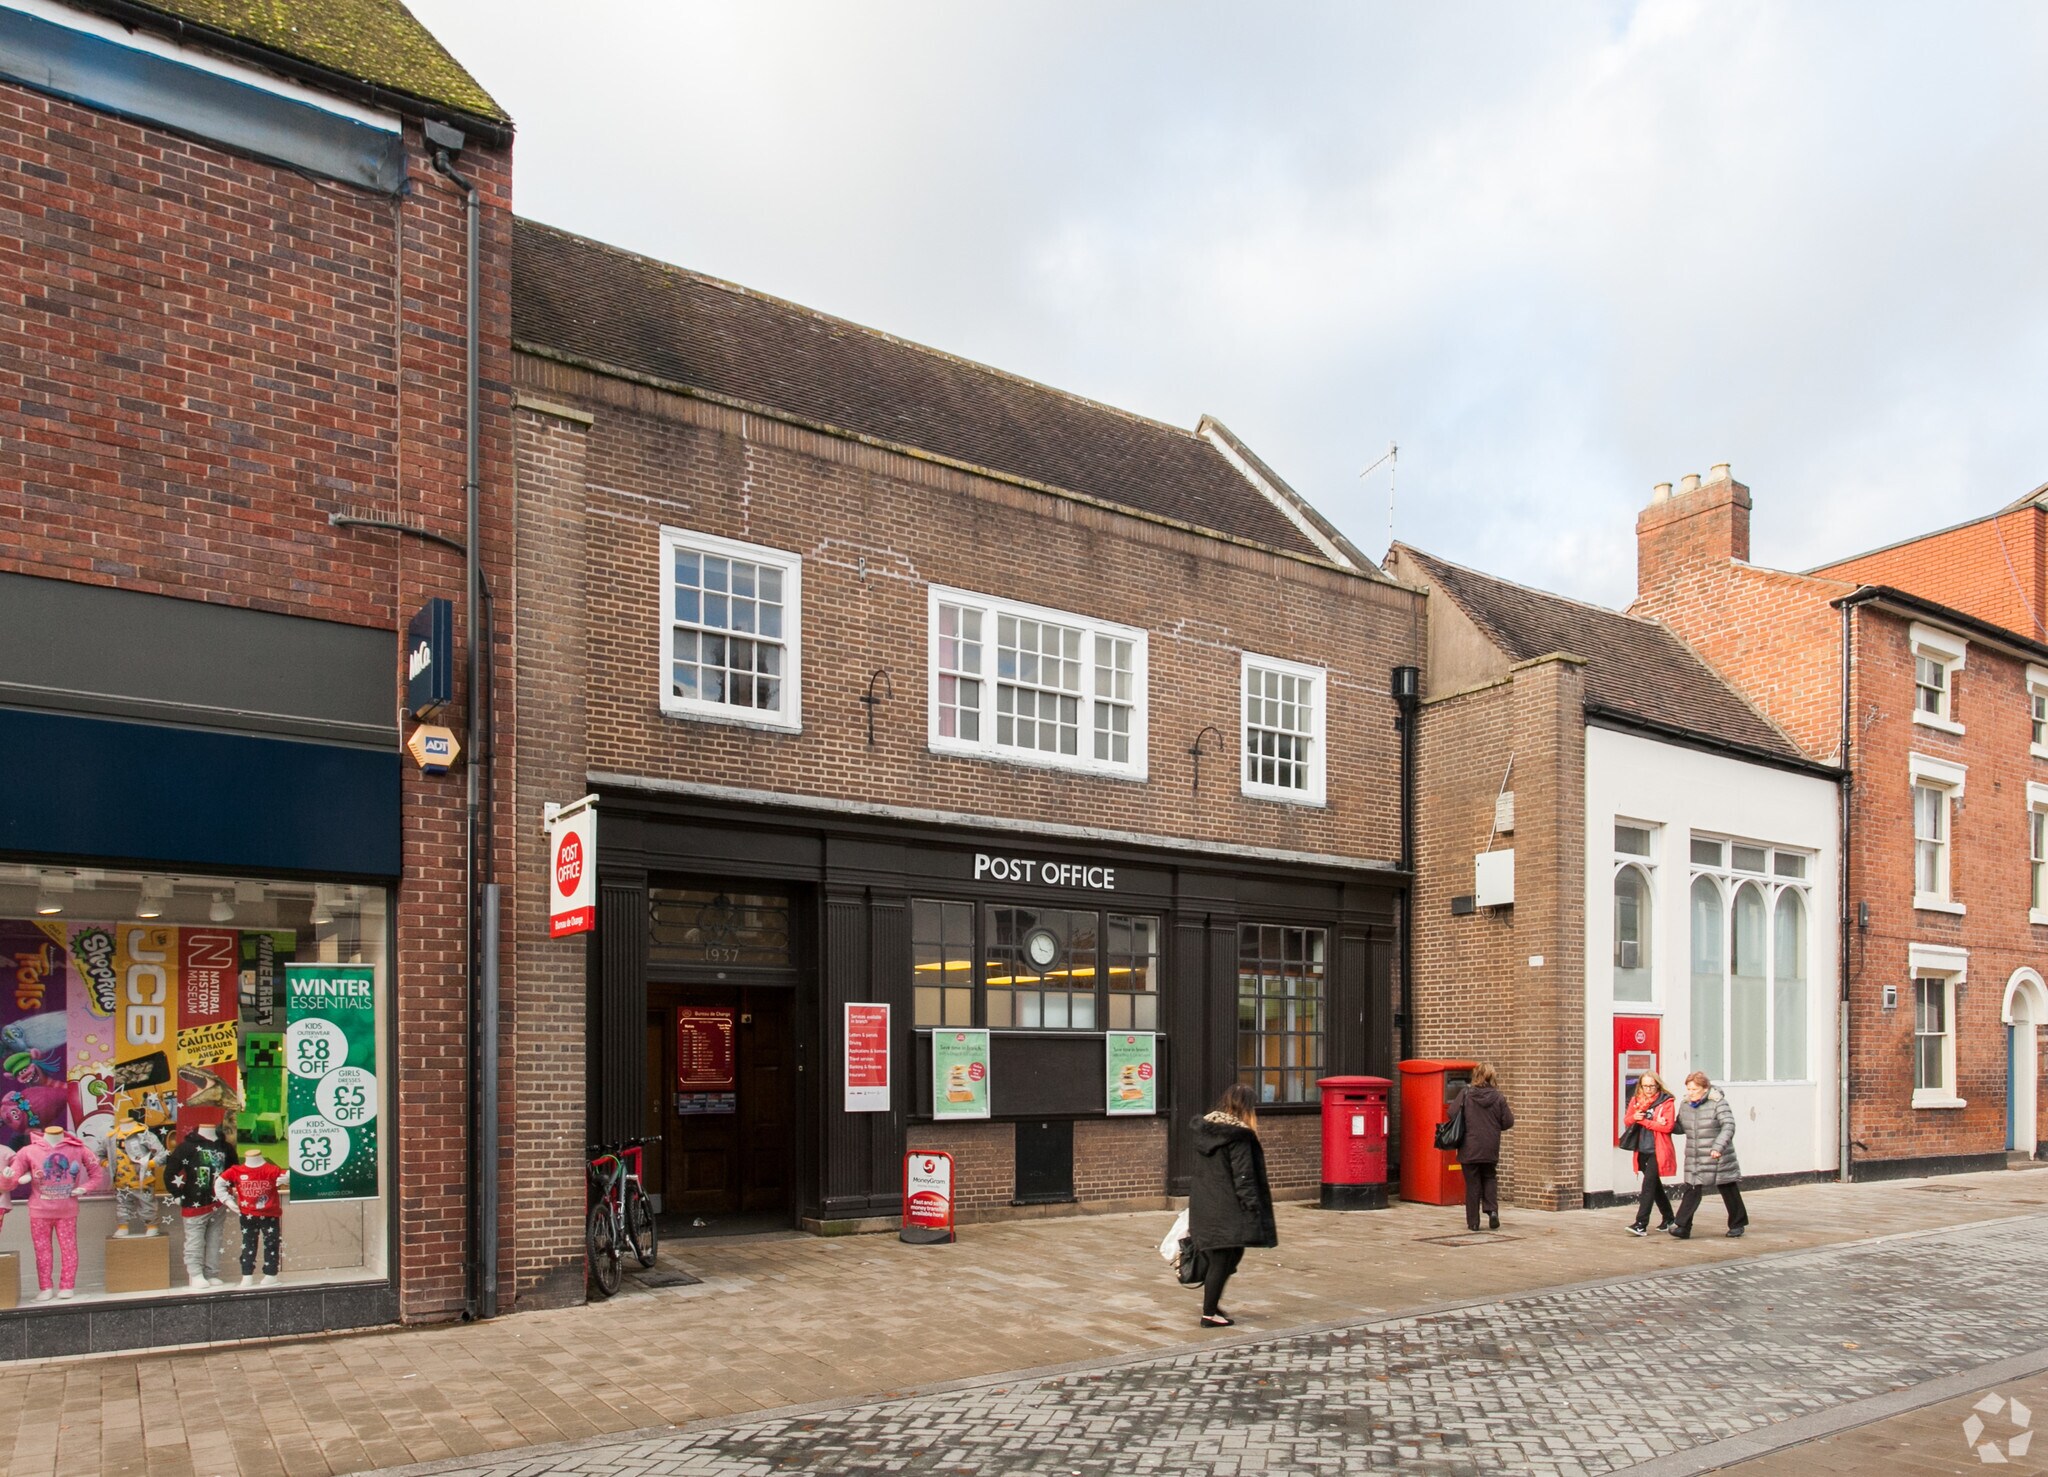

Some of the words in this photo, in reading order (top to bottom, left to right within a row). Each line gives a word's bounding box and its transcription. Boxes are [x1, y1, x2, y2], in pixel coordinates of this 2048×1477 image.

[426, 739, 448, 752] ADT
[562, 843, 578, 864] POST
[558, 861, 580, 882] OFFICE
[974, 853, 1036, 882] POST
[1041, 862, 1114, 890] OFFICE
[705, 948, 739, 962] 1937
[15, 942, 50, 1010] Trolls
[259, 934, 274, 1026] MINECRAFT
[127, 928, 166, 1046] JCB
[187, 970, 197, 1014] MUSEUM
[198, 970, 208, 1015] HISTORY
[210, 971, 219, 1015] NATURAL
[291, 978, 370, 996] WINTER
[291, 996, 372, 1010] ESSENTIALS
[179, 1030, 233, 1048] CAUTION
[187, 1041, 232, 1054] DINOSAURS
[297, 1039, 330, 1060] £8
[198, 1049, 224, 1060] AHEAD
[300, 1061, 329, 1074] OFF
[333, 1086, 365, 1107] £5
[335, 1107, 364, 1120] OFF
[299, 1136, 332, 1158] £3
[301, 1158, 330, 1172] OFF
